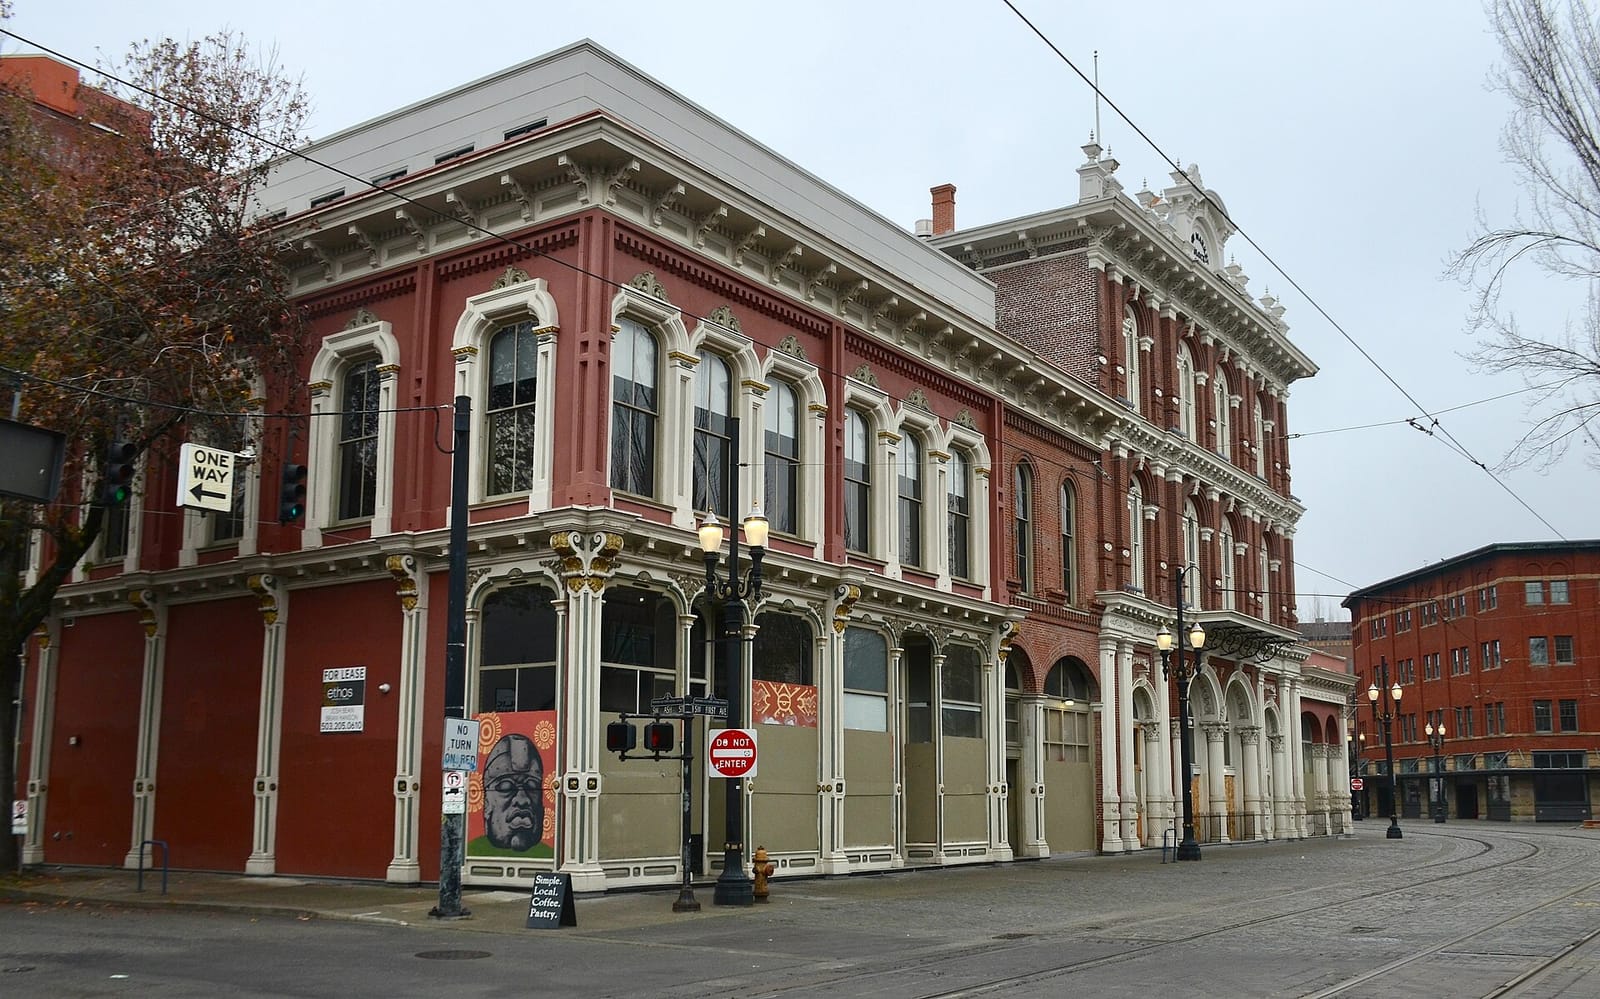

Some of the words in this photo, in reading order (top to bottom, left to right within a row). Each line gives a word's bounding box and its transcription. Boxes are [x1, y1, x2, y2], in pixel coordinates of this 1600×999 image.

[194, 450, 229, 468] ONE
[193, 465, 229, 483] WAY
[324, 670, 338, 681] FOR
[341, 668, 365, 679] LEASE
[327, 687, 353, 698] ethos
[457, 725, 468, 735] NO
[450, 738, 472, 751] TURN
[716, 738, 728, 747] DO
[732, 738, 750, 747] NOT
[444, 752, 456, 764] ON
[460, 753, 476, 765] RED
[719, 759, 747, 768] ENTER
[535, 875, 562, 886] Simple.
[533, 886, 558, 896] Local.
[531, 897, 561, 908] Coffee.
[530, 908, 558, 920] Pastry.
